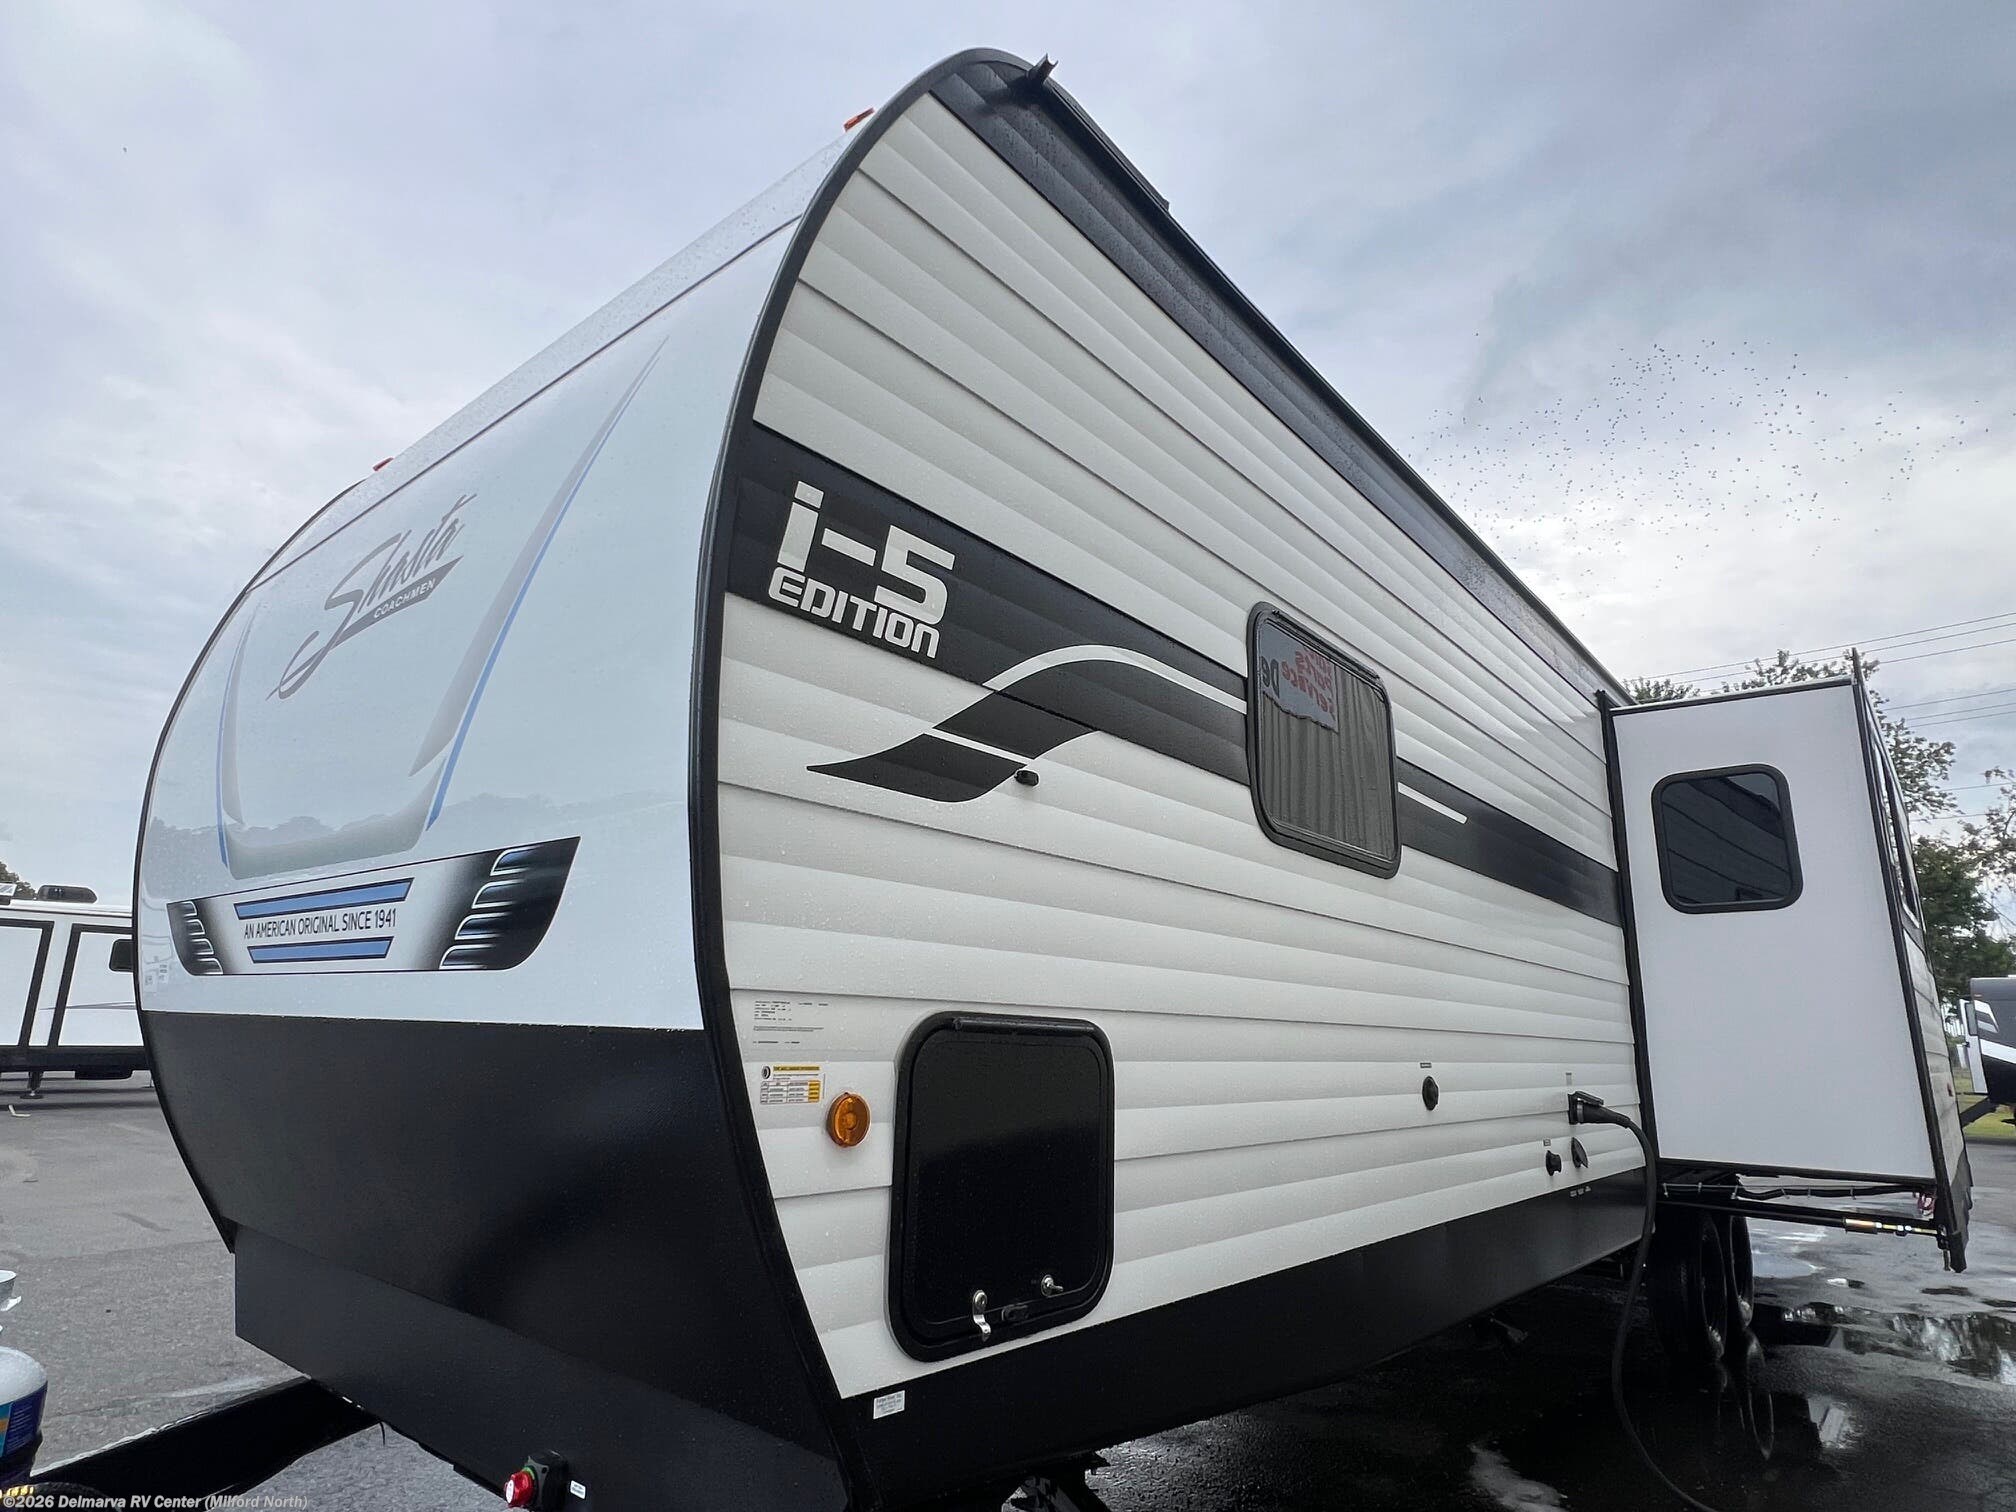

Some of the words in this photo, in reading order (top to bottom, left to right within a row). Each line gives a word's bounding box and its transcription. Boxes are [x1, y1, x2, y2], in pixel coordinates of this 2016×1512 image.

[777, 480, 955, 625] i-5
[373, 577, 437, 619] COACHMEN
[768, 566, 940, 659] EDITION
[244, 923, 255, 939] AN
[256, 918, 297, 939] AMERICAN
[298, 915, 340, 936] ORIGINAL
[342, 911, 372, 931] SINCE
[374, 907, 397, 929] 1941
